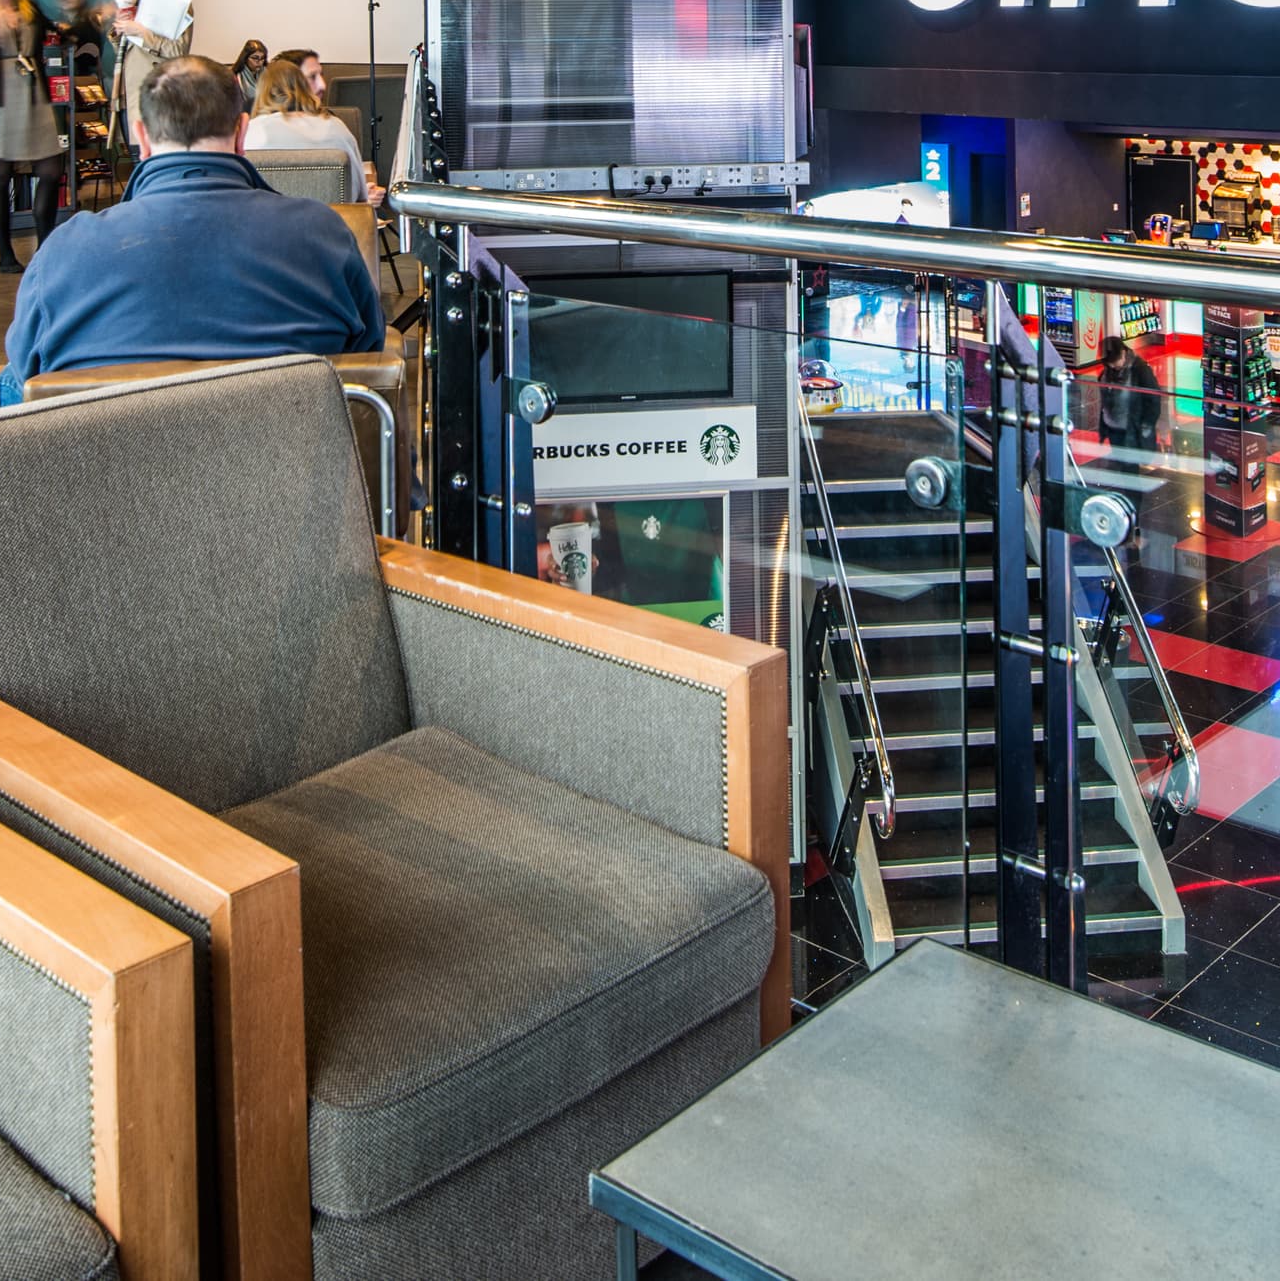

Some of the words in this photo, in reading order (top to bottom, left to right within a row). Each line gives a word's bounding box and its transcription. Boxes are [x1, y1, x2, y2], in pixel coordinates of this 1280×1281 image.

[926, 162, 941, 181] 2
[532, 443, 610, 459] RBUCKS
[616, 440, 687, 456] COFFEE
